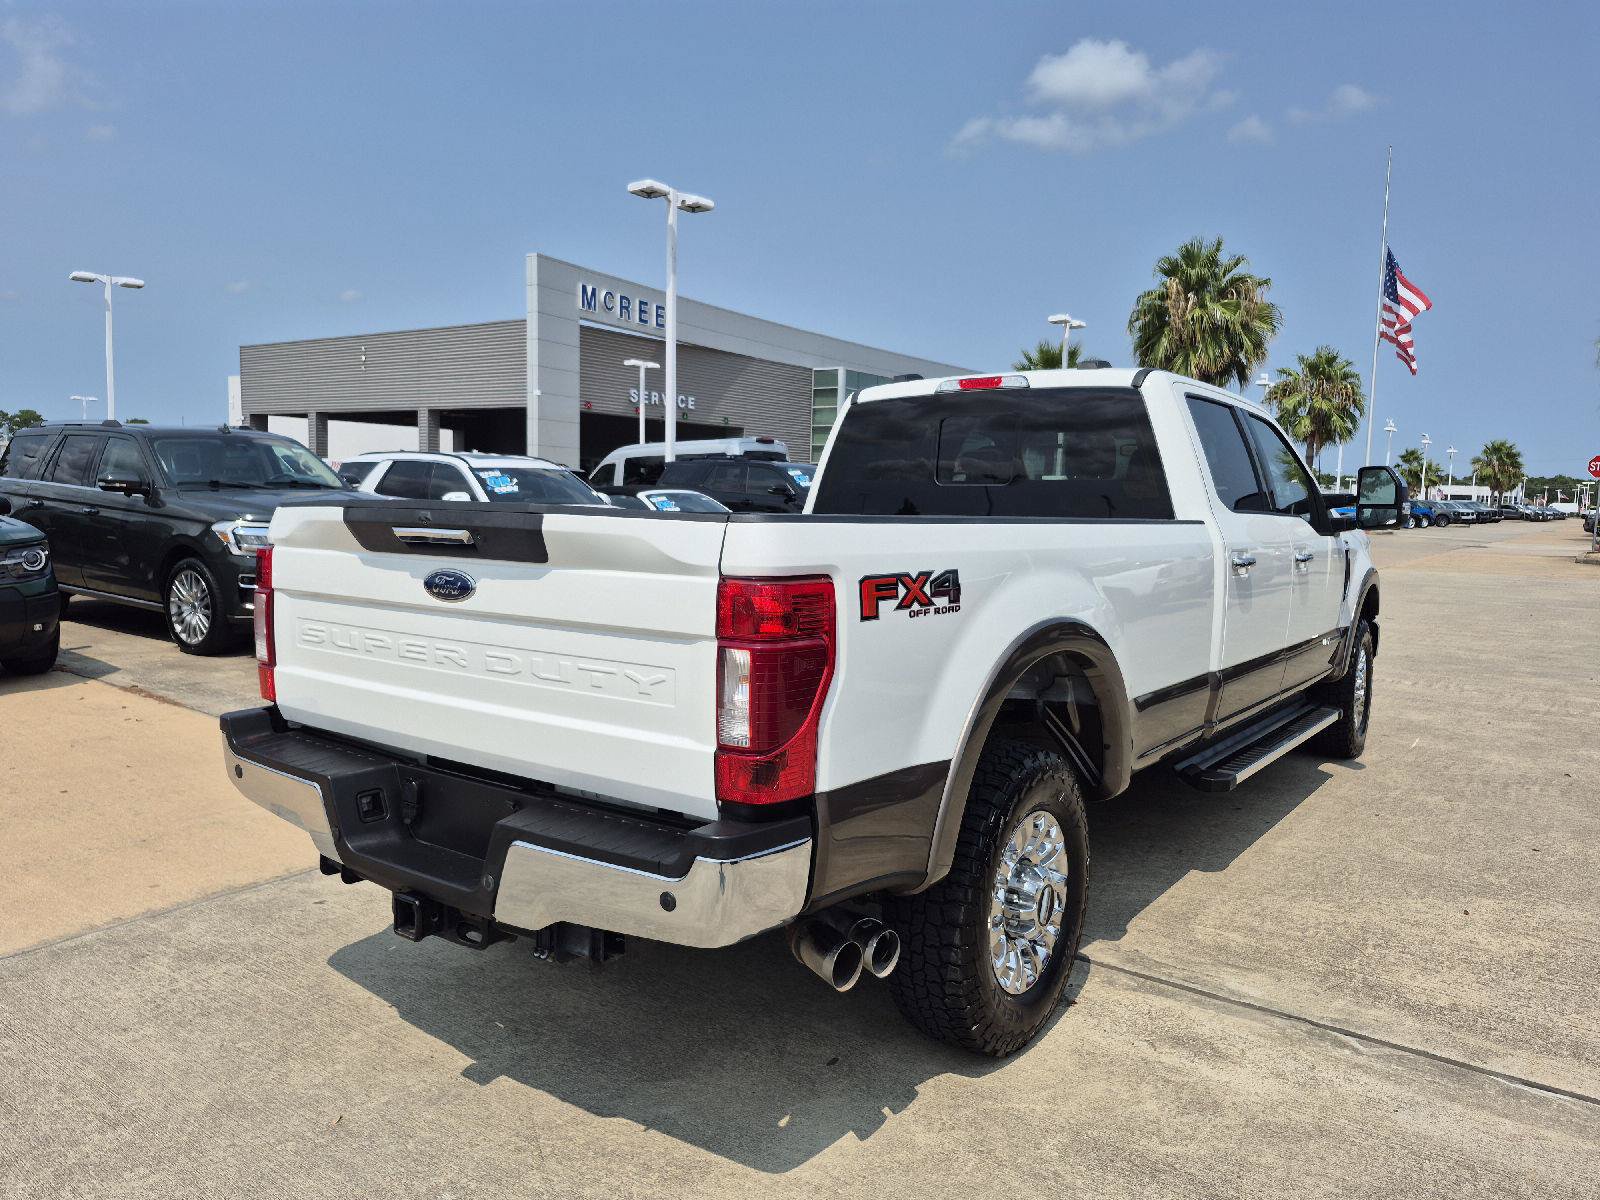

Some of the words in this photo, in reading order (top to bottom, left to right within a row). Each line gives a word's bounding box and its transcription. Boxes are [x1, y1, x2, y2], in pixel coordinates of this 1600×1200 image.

[579, 283, 666, 329] MCREE
[629, 389, 696, 409] SERVCE
[1590, 461, 1600, 471] ST
[433, 575, 461, 595] Ford
[858, 569, 961, 622] FX4
[908, 608, 931, 618] OFF
[934, 605, 961, 616] ROAD
[301, 624, 468, 669] SUPER
[485, 651, 667, 696] DUTY
